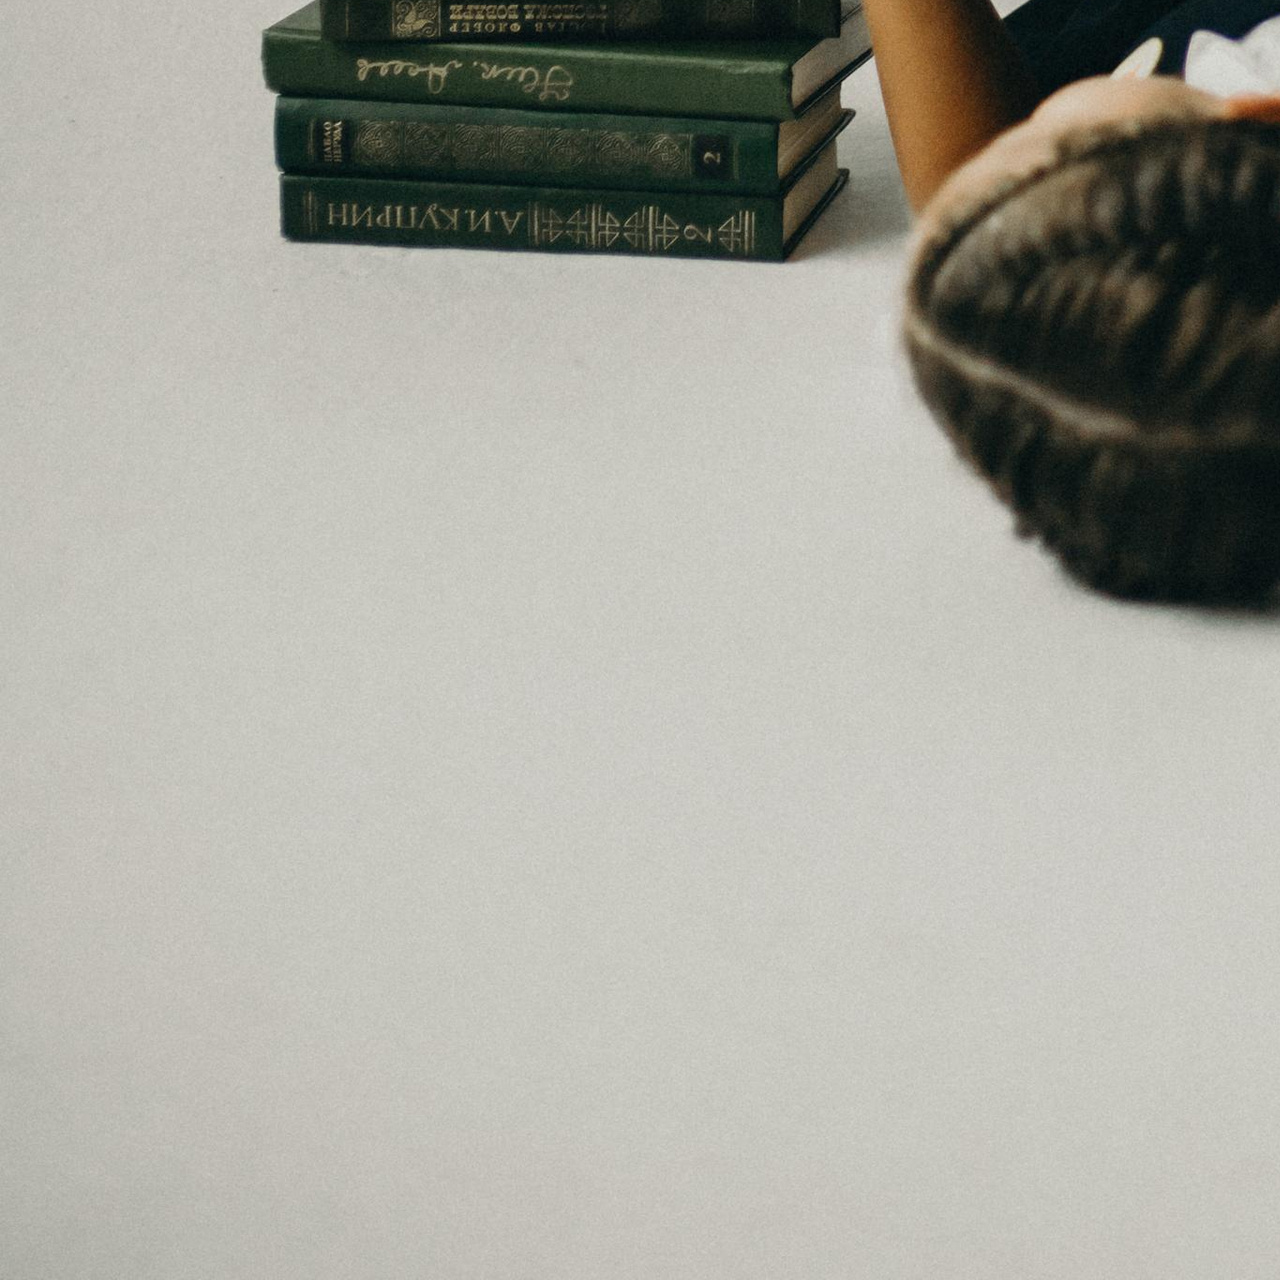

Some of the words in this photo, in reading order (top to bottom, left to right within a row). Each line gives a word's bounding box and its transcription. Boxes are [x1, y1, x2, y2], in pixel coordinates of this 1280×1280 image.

[449, 4, 520, 20] БОВАРИ
[448, 21, 522, 33] ФЛОБЕР
[323, 121, 333, 162] ПАБЛО
[702, 151, 721, 165] 2
[327, 202, 524, 236] А.И.КУПРИН
[683, 224, 712, 244] 2
